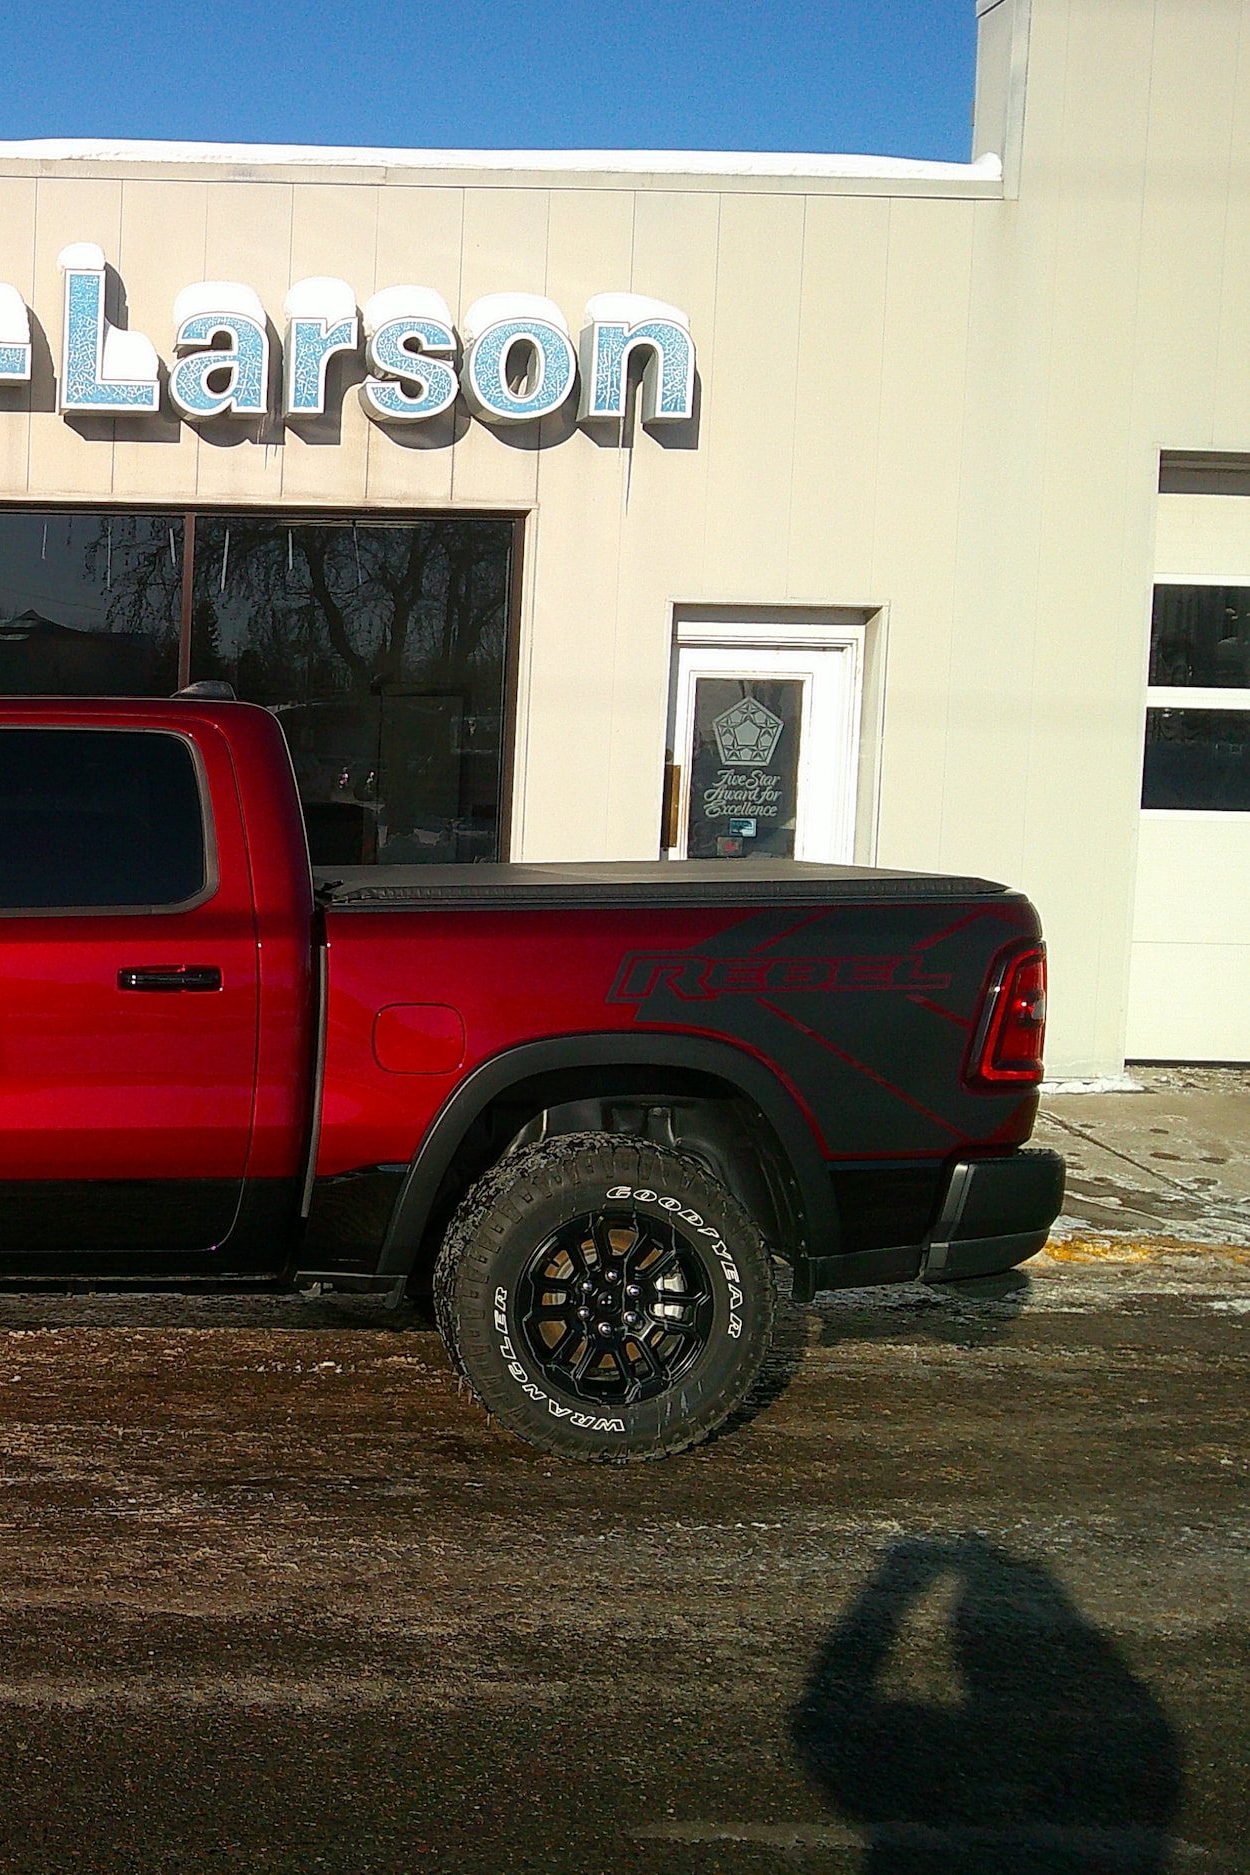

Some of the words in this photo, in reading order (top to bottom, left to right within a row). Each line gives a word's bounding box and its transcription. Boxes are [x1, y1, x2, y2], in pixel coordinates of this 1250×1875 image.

[703, 785, 760, 801] Award
[754, 786, 783, 804] for
[711, 769, 747, 787] Five
[745, 769, 781, 789] Star
[703, 799, 778, 818] Excellence
[616, 954, 950, 1000] REBEL
[605, 1186, 743, 1339] GOODYEAR
[493, 1287, 625, 1432] WRANGLER
